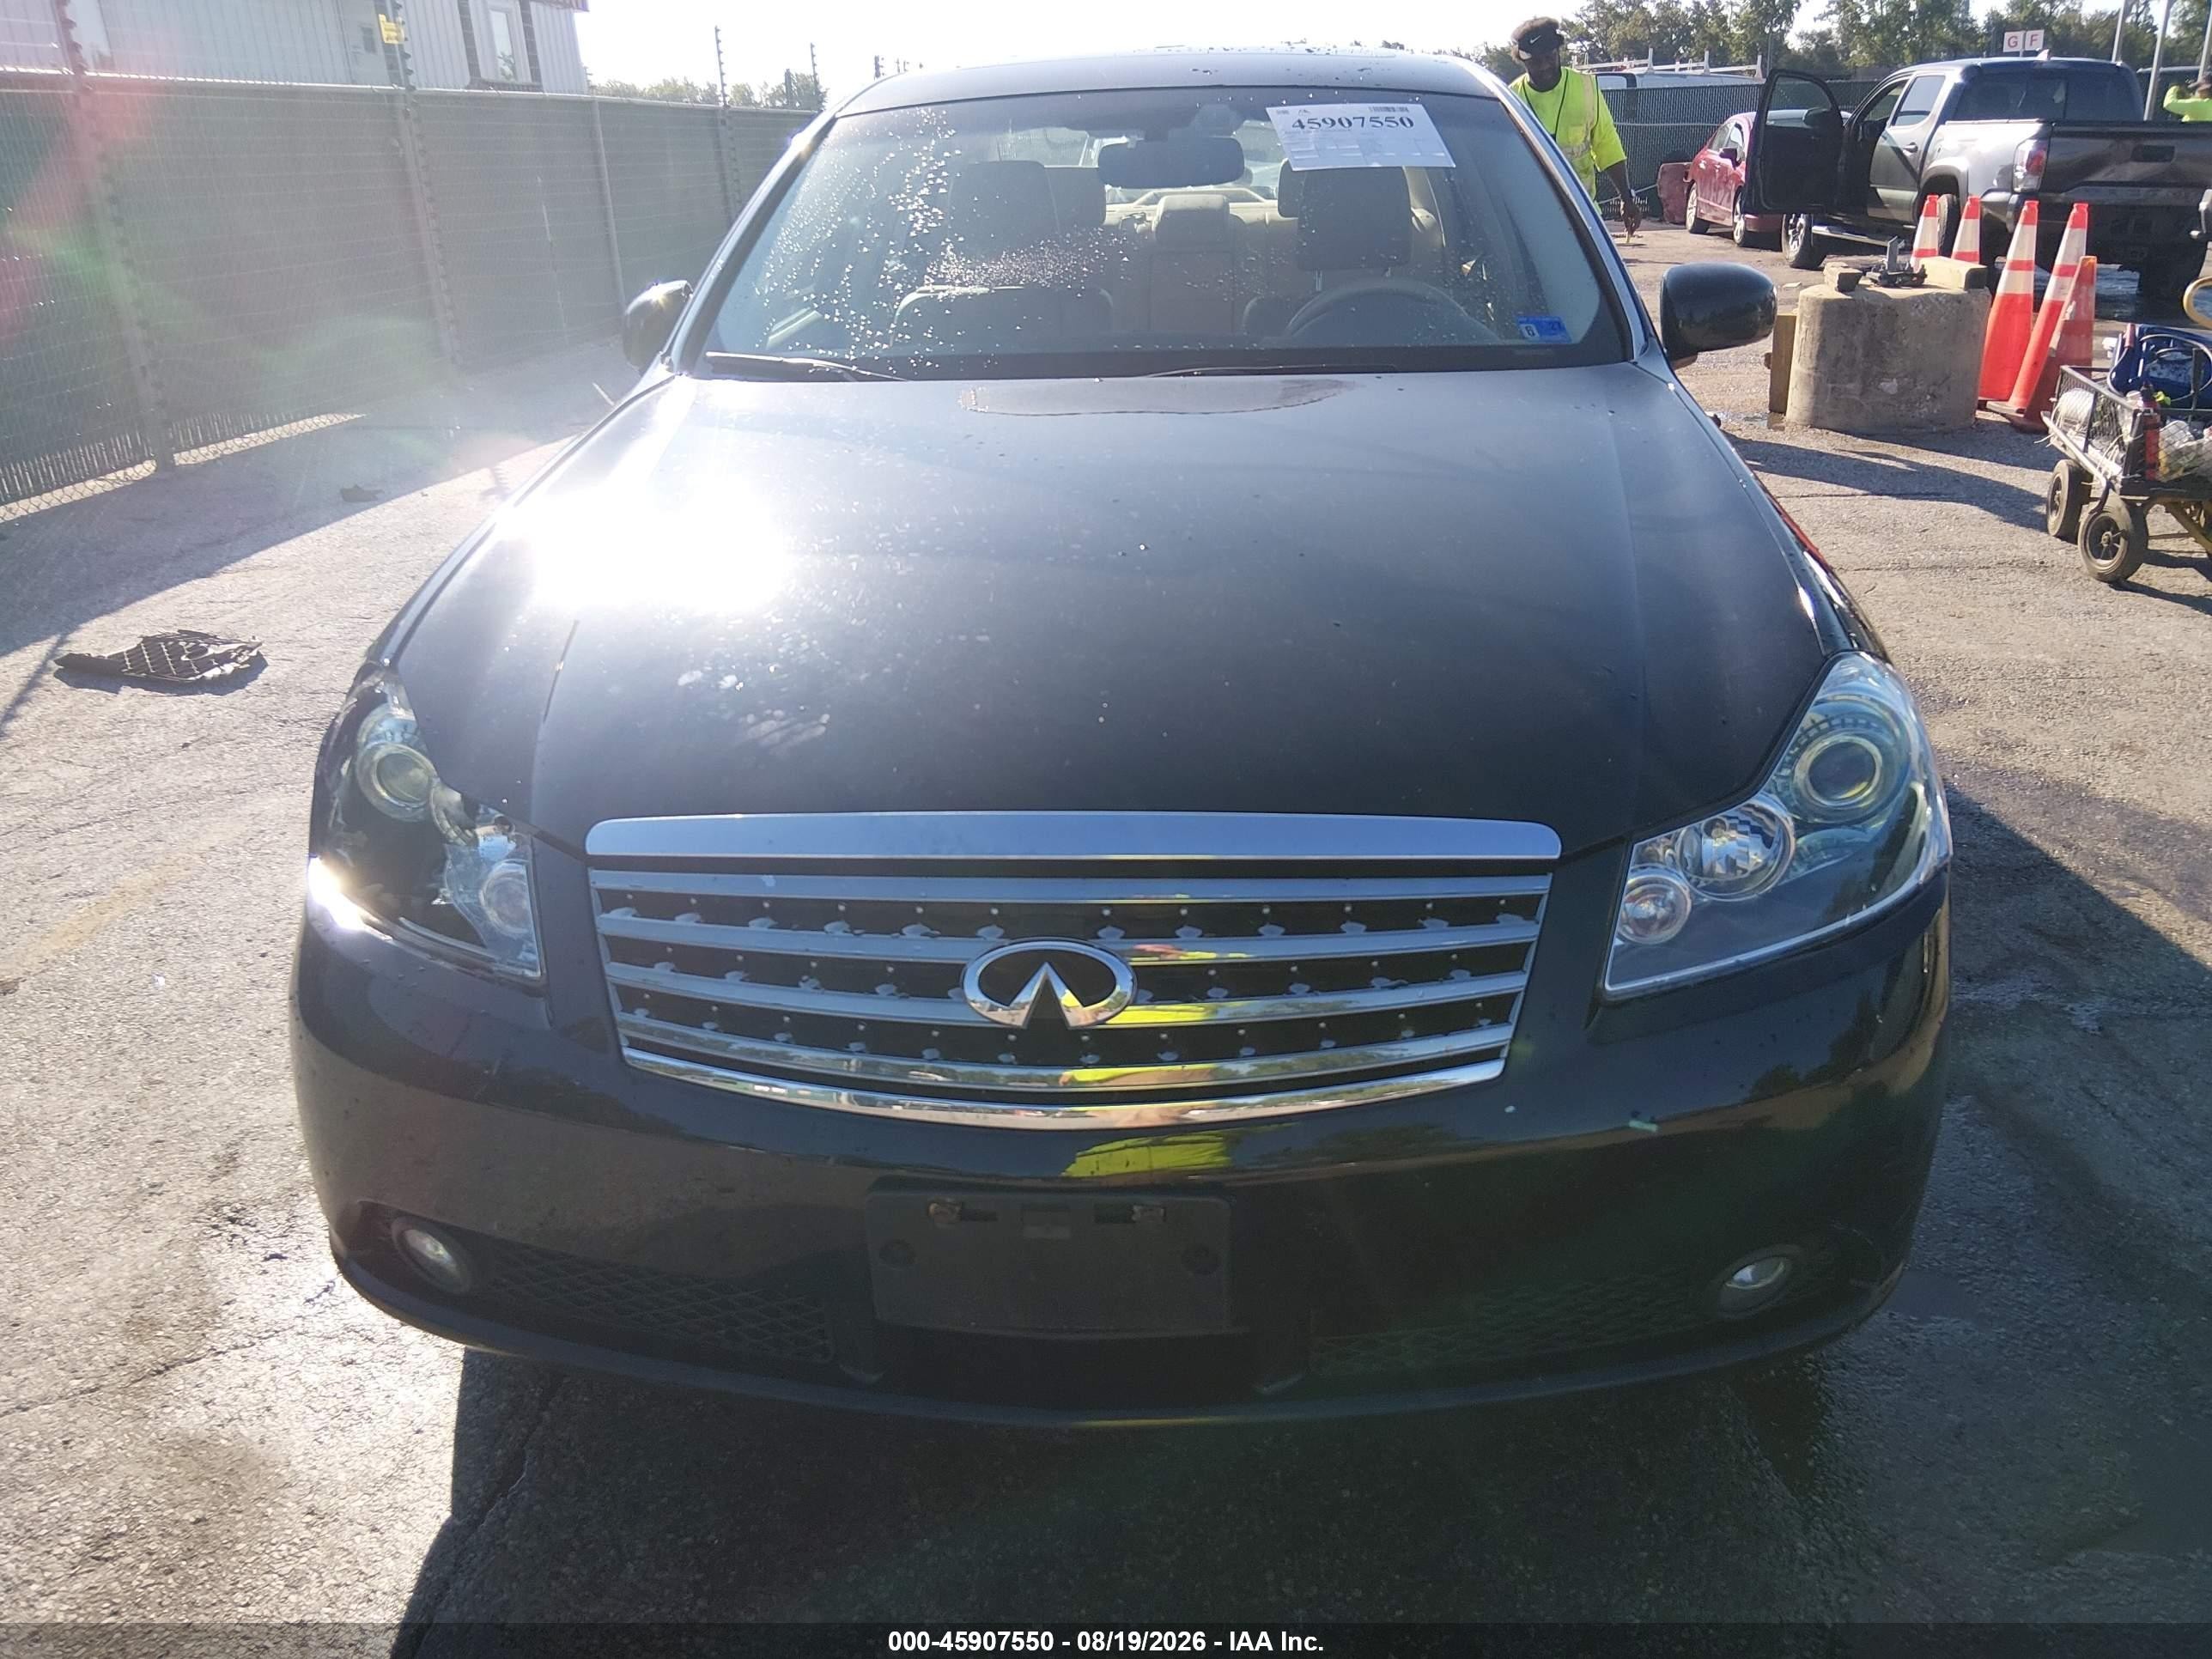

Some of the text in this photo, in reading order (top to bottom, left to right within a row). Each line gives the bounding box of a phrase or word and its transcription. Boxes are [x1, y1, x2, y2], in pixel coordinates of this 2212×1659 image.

[2007, 34, 2039, 48] G F
[1291, 116, 1415, 130] 45907550
